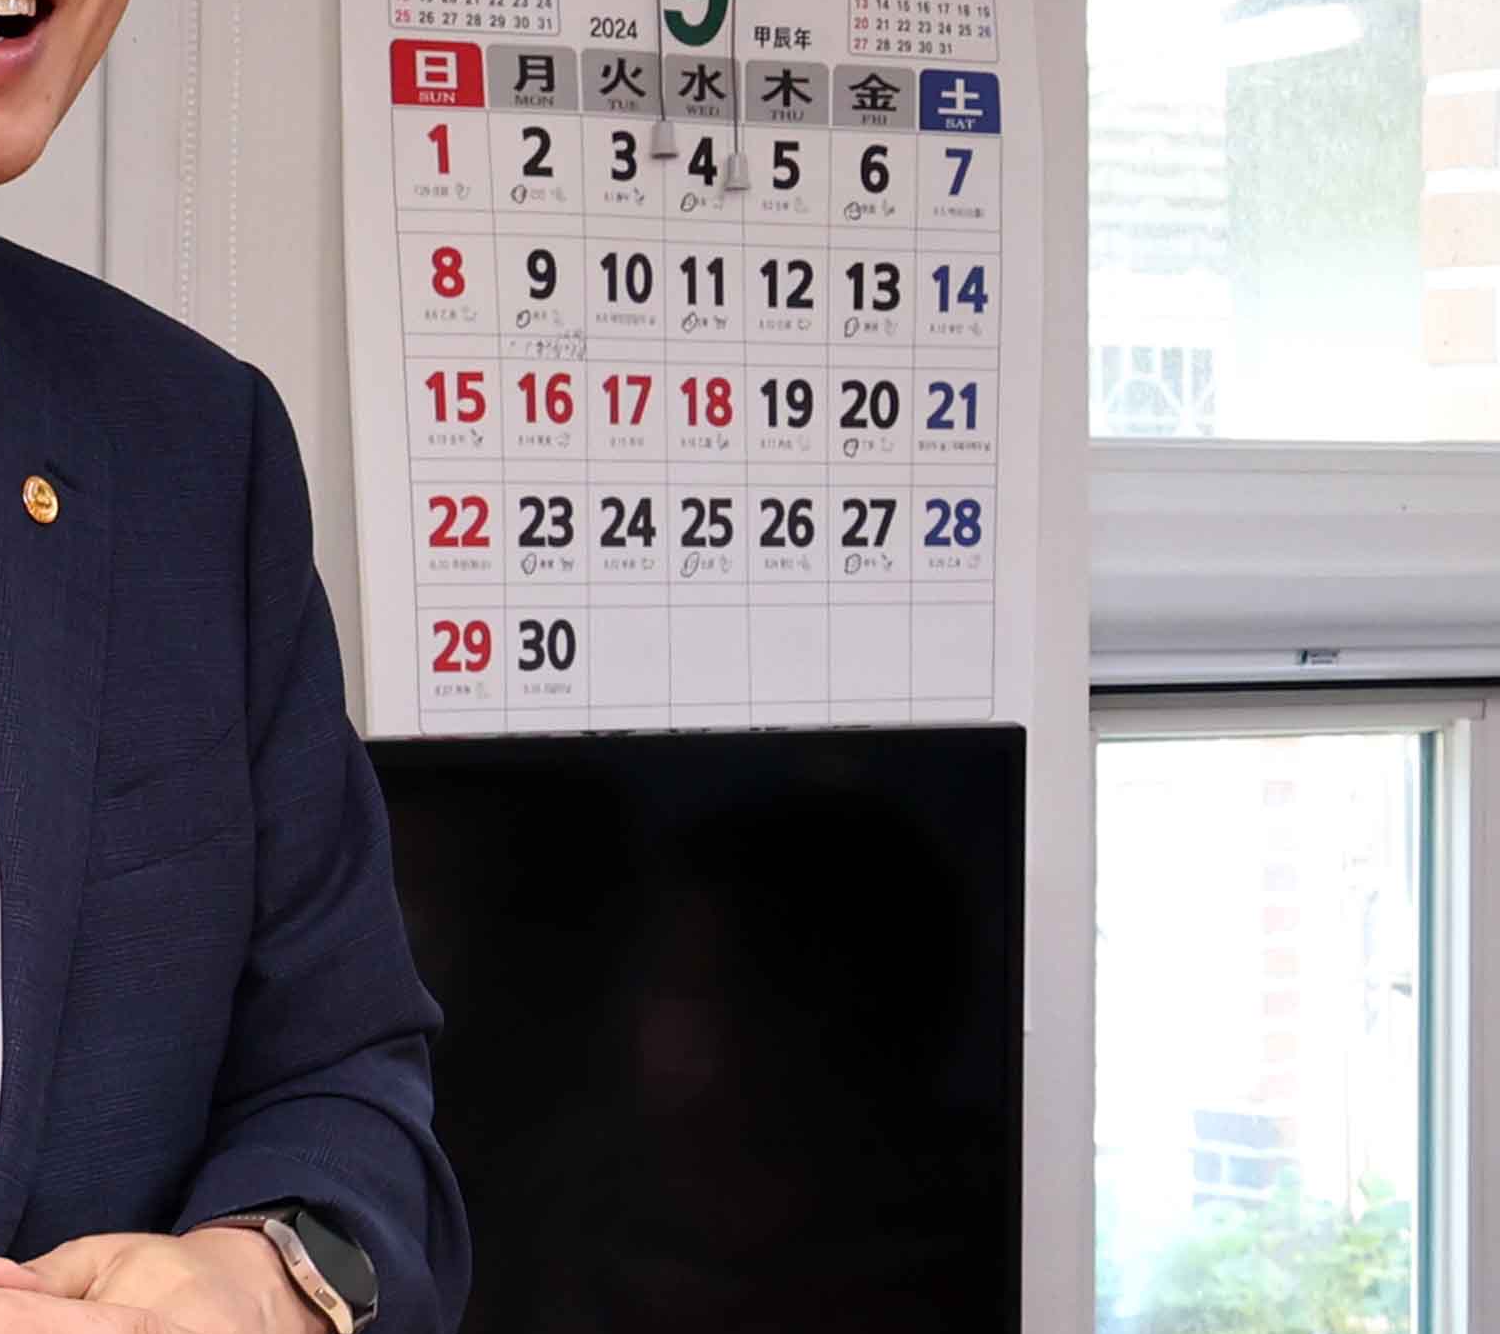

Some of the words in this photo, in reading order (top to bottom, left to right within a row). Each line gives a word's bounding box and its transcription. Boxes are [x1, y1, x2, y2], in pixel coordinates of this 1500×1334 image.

[396, 10, 410, 22] 25
[419, 12, 434, 24] 26
[443, 13, 457, 24] 27
[466, 14, 481, 26] 28
[490, 15, 505, 27] 29
[514, 17, 529, 28] 30
[538, 18, 552, 29] 31
[877, 0, 889, 10] 14
[898, 0, 909, 11] 15
[918, 2, 930, 13] 16
[938, 4, 949, 14] 17
[590, 16, 638, 40] 2024
[754, 25, 812, 51] 甲辰年
[854, 18, 868, 29] 20
[877, 19, 889, 30] 21
[898, 20, 910, 31] 22
[918, 22, 931, 33] 23
[939, 23, 951, 34] 24
[958, 25, 971, 36] 25
[854, 38, 868, 49] 27
[876, 39, 890, 51] 28
[898, 40, 911, 52] 29
[919, 42, 932, 53] 30
[940, 43, 952, 54] 31
[416, 50, 458, 89] 日
[513, 55, 555, 92] 月
[600, 58, 646, 97] 火
[679, 65, 726, 101] 水
[762, 69, 812, 107] 木
[849, 73, 900, 111] 金
[938, 79, 983, 115] 土
[419, 92, 456, 103] SUN
[515, 96, 554, 107] MON
[608, 99, 638, 111] TUE
[685, 106, 720, 117] WED
[771, 109, 803, 121] THU
[945, 120, 975, 130] SAT
[427, 123, 450, 175] 1
[522, 126, 554, 178] 2
[611, 130, 637, 182] 3
[687, 136, 718, 187] 4
[772, 140, 800, 190] 5
[860, 144, 890, 194] 6
[945, 147, 973, 196] 7
[431, 246, 466, 299] 8
[526, 248, 557, 300] 9
[600, 252, 653, 304] 10
[679, 255, 724, 307] 11
[759, 258, 814, 309] 12
[845, 262, 901, 312] 13
[931, 264, 989, 314] 14
[425, 371, 486, 423] 15
[517, 372, 574, 425] 16
[602, 374, 652, 426] 17
[680, 376, 733, 428] 18
[760, 378, 814, 429] 19
[839, 379, 900, 430] 20
[926, 381, 977, 430] 21
[428, 495, 490, 548] 22
[518, 495, 574, 548] 23
[600, 496, 657, 548] 24
[680, 497, 734, 548] 25
[759, 498, 815, 548] 26
[841, 498, 897, 548] 27
[923, 498, 982, 548] 28
[432, 620, 492, 673] 29
[518, 618, 576, 672] 30
